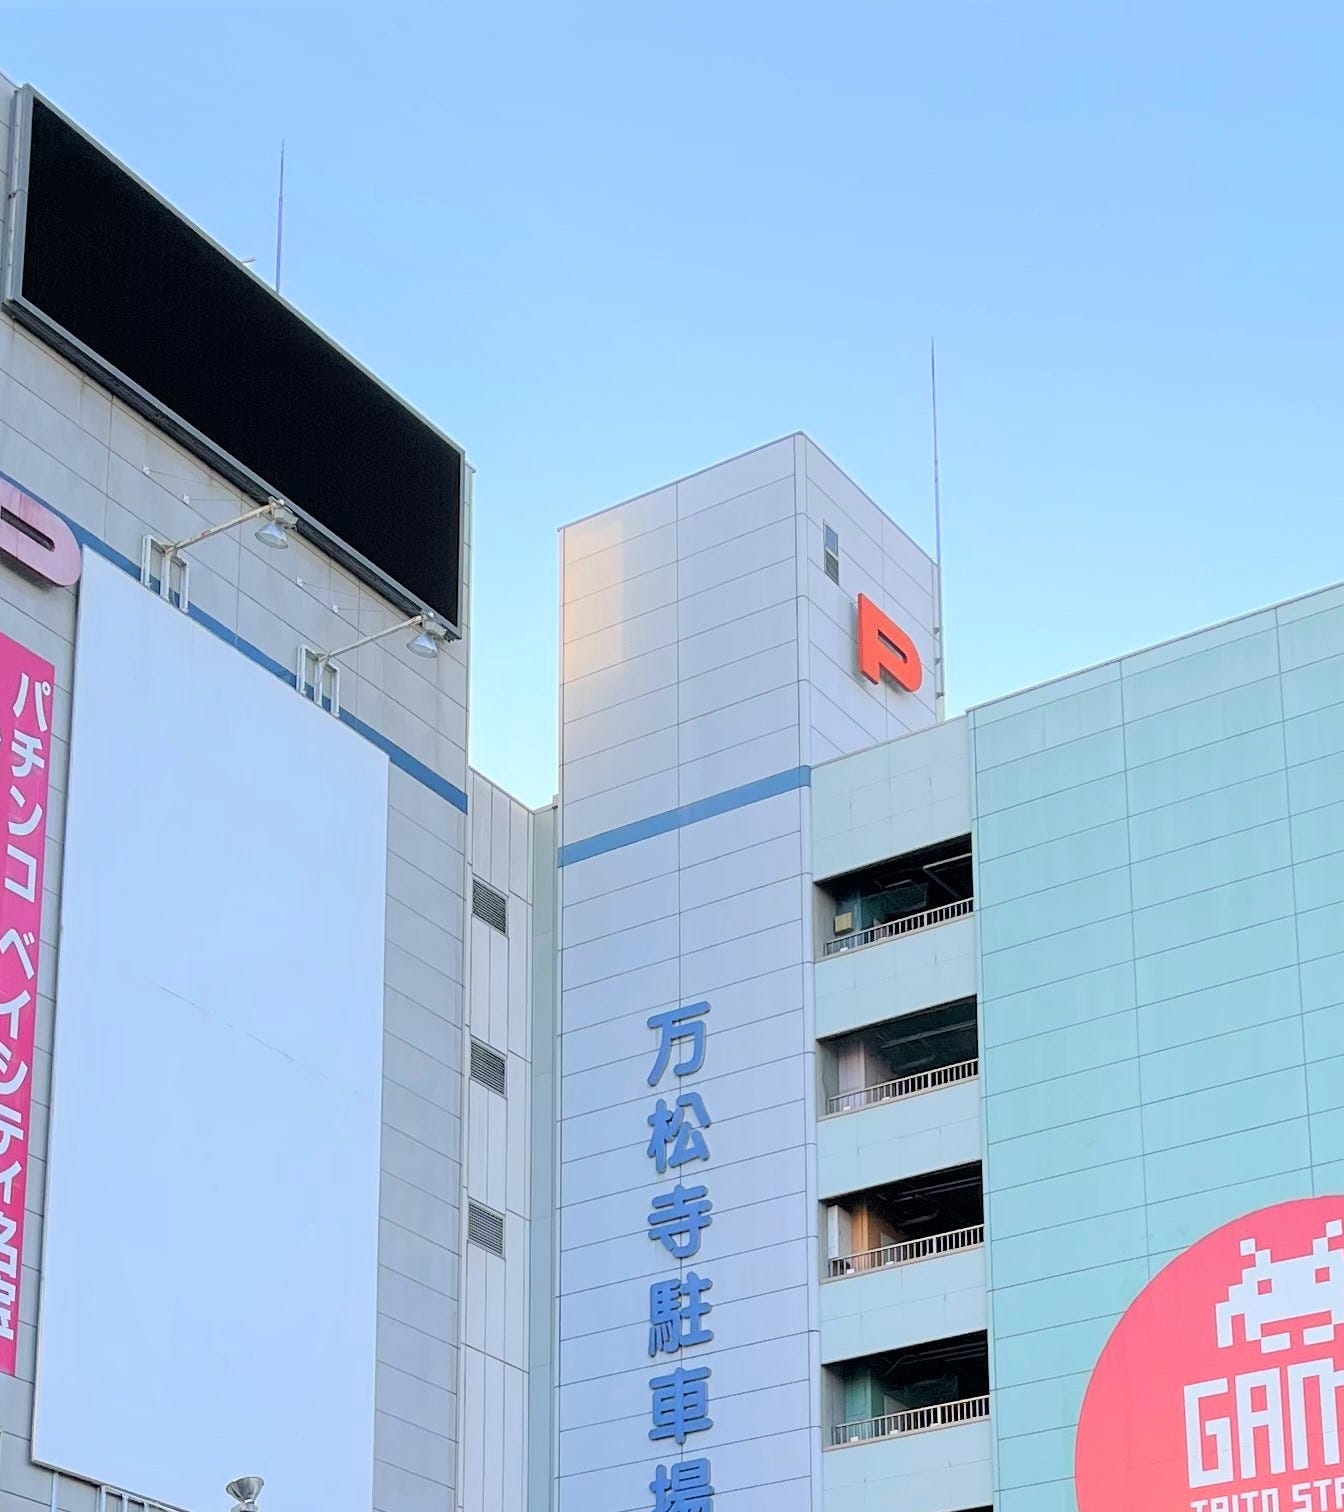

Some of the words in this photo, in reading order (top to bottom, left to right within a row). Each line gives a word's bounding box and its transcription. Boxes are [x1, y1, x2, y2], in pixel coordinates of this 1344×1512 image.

[857, 593, 923, 692] P
[2, 670, 52, 906] パチンコ
